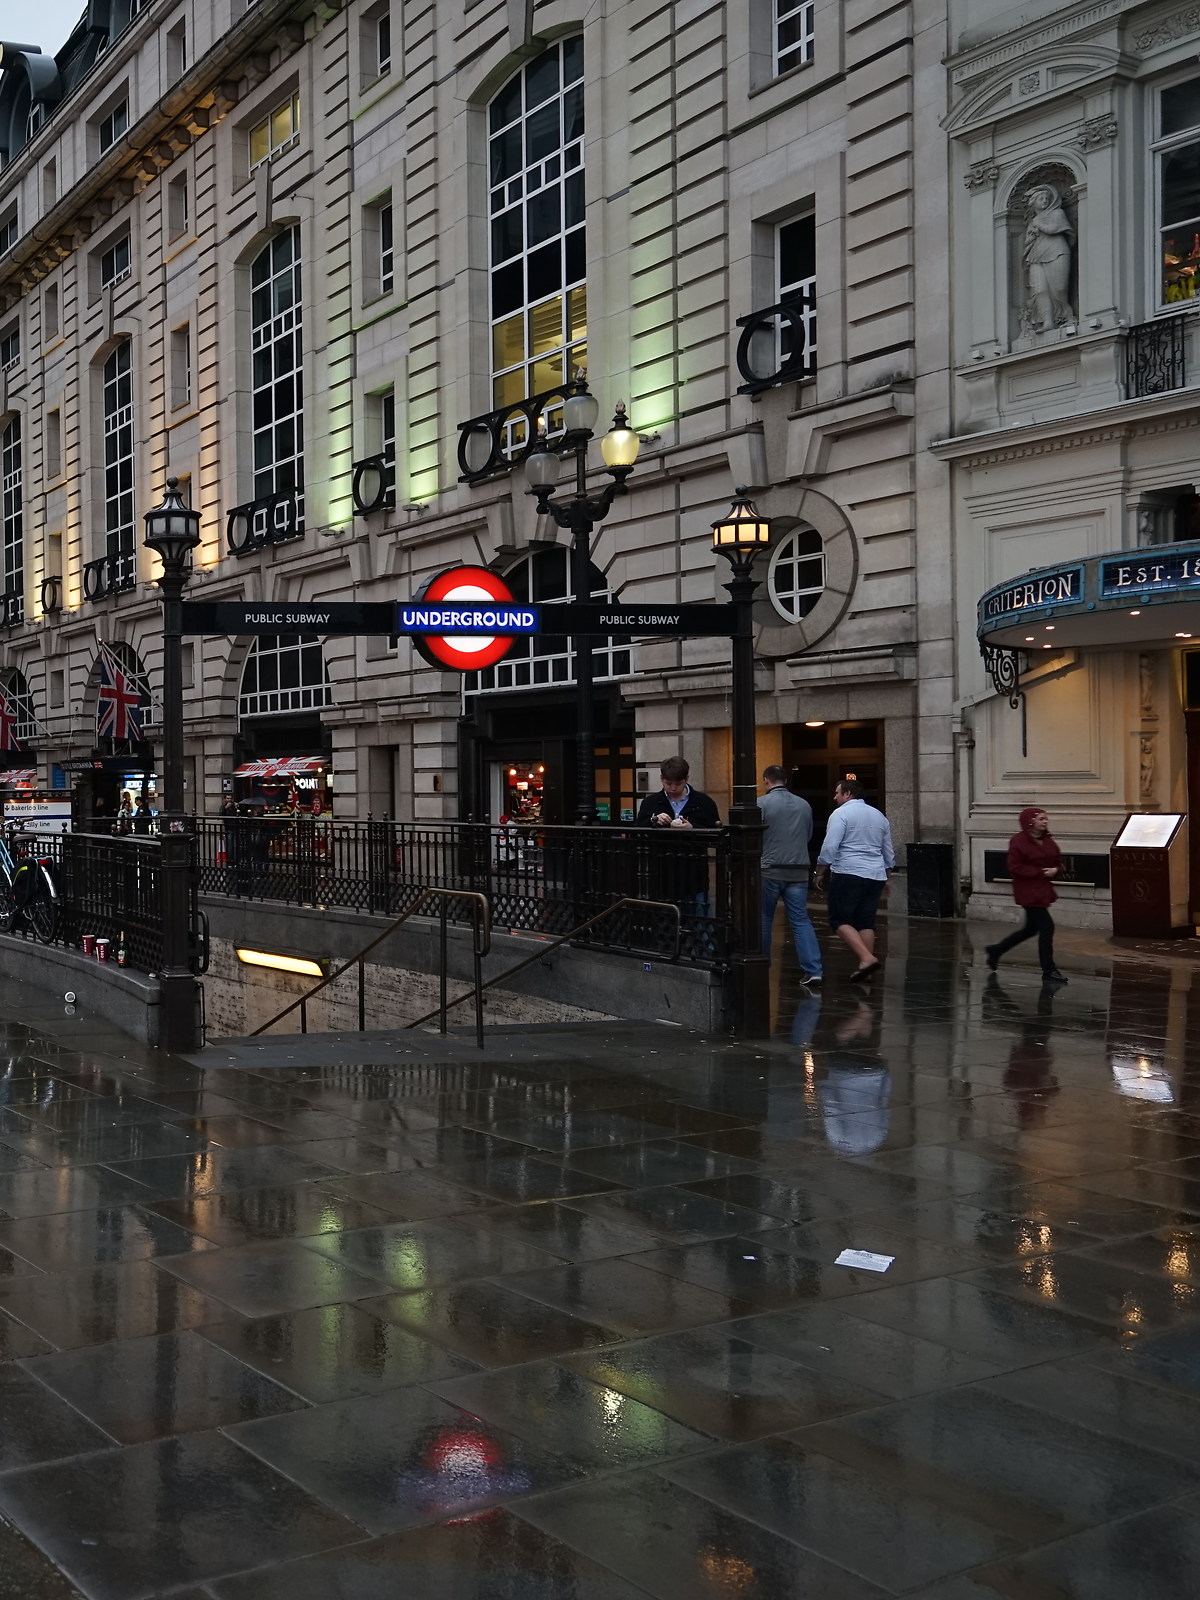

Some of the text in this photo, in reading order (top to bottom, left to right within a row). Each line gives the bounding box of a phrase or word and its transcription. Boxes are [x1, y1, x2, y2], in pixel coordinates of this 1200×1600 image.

[988, 573, 1074, 615] CRITERION
[244, 613, 331, 624] PUBLIC SUBWAY
[402, 611, 534, 627] UNDERGROUND
[599, 615, 680, 625] PUBLIC SUBWAY
